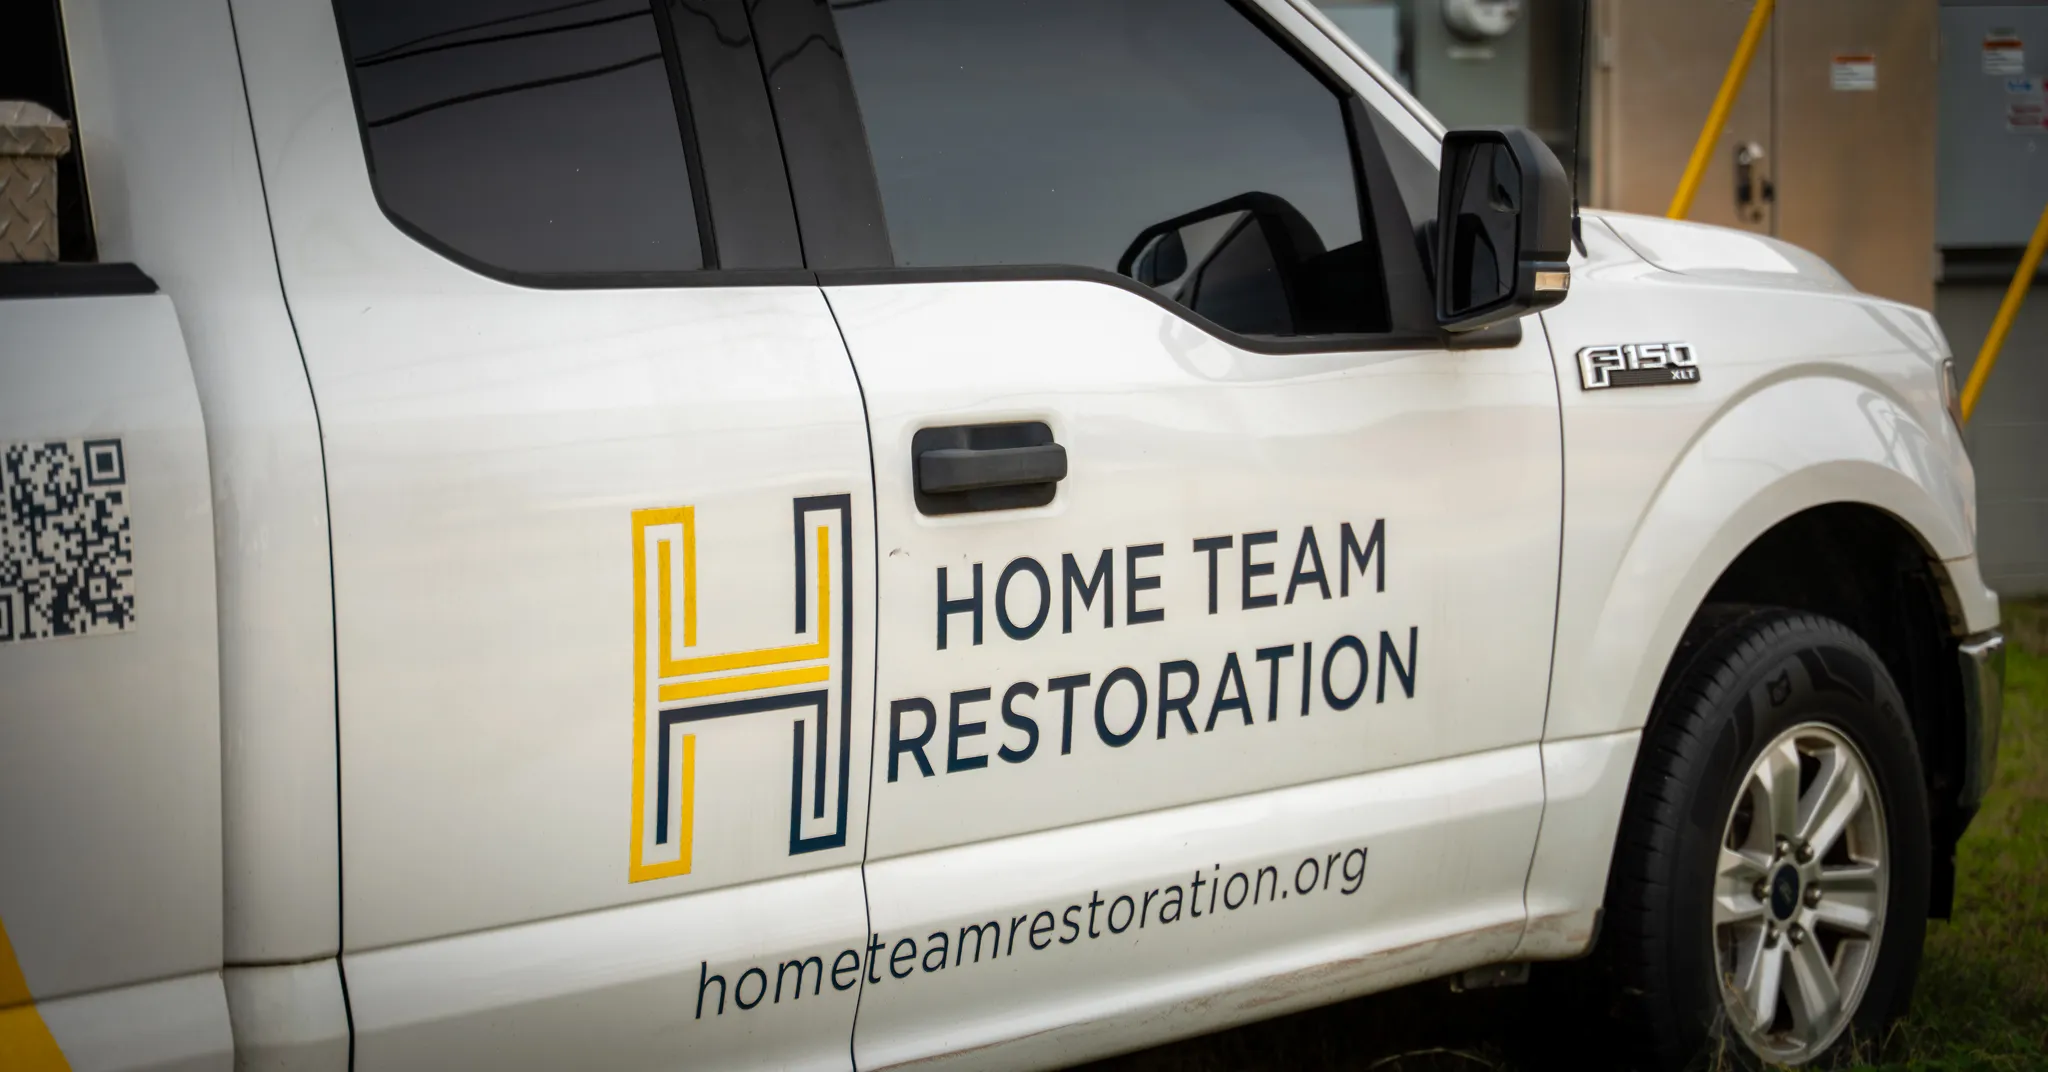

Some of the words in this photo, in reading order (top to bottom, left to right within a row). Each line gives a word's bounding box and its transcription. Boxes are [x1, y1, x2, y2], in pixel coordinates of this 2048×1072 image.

[1671, 369, 1696, 380] XLT
[936, 542, 1165, 651] HOME
[1193, 518, 1386, 615] TEAM
[887, 626, 1419, 784] RESTORATION
[694, 846, 1369, 1021] hometeamrestoration.org
